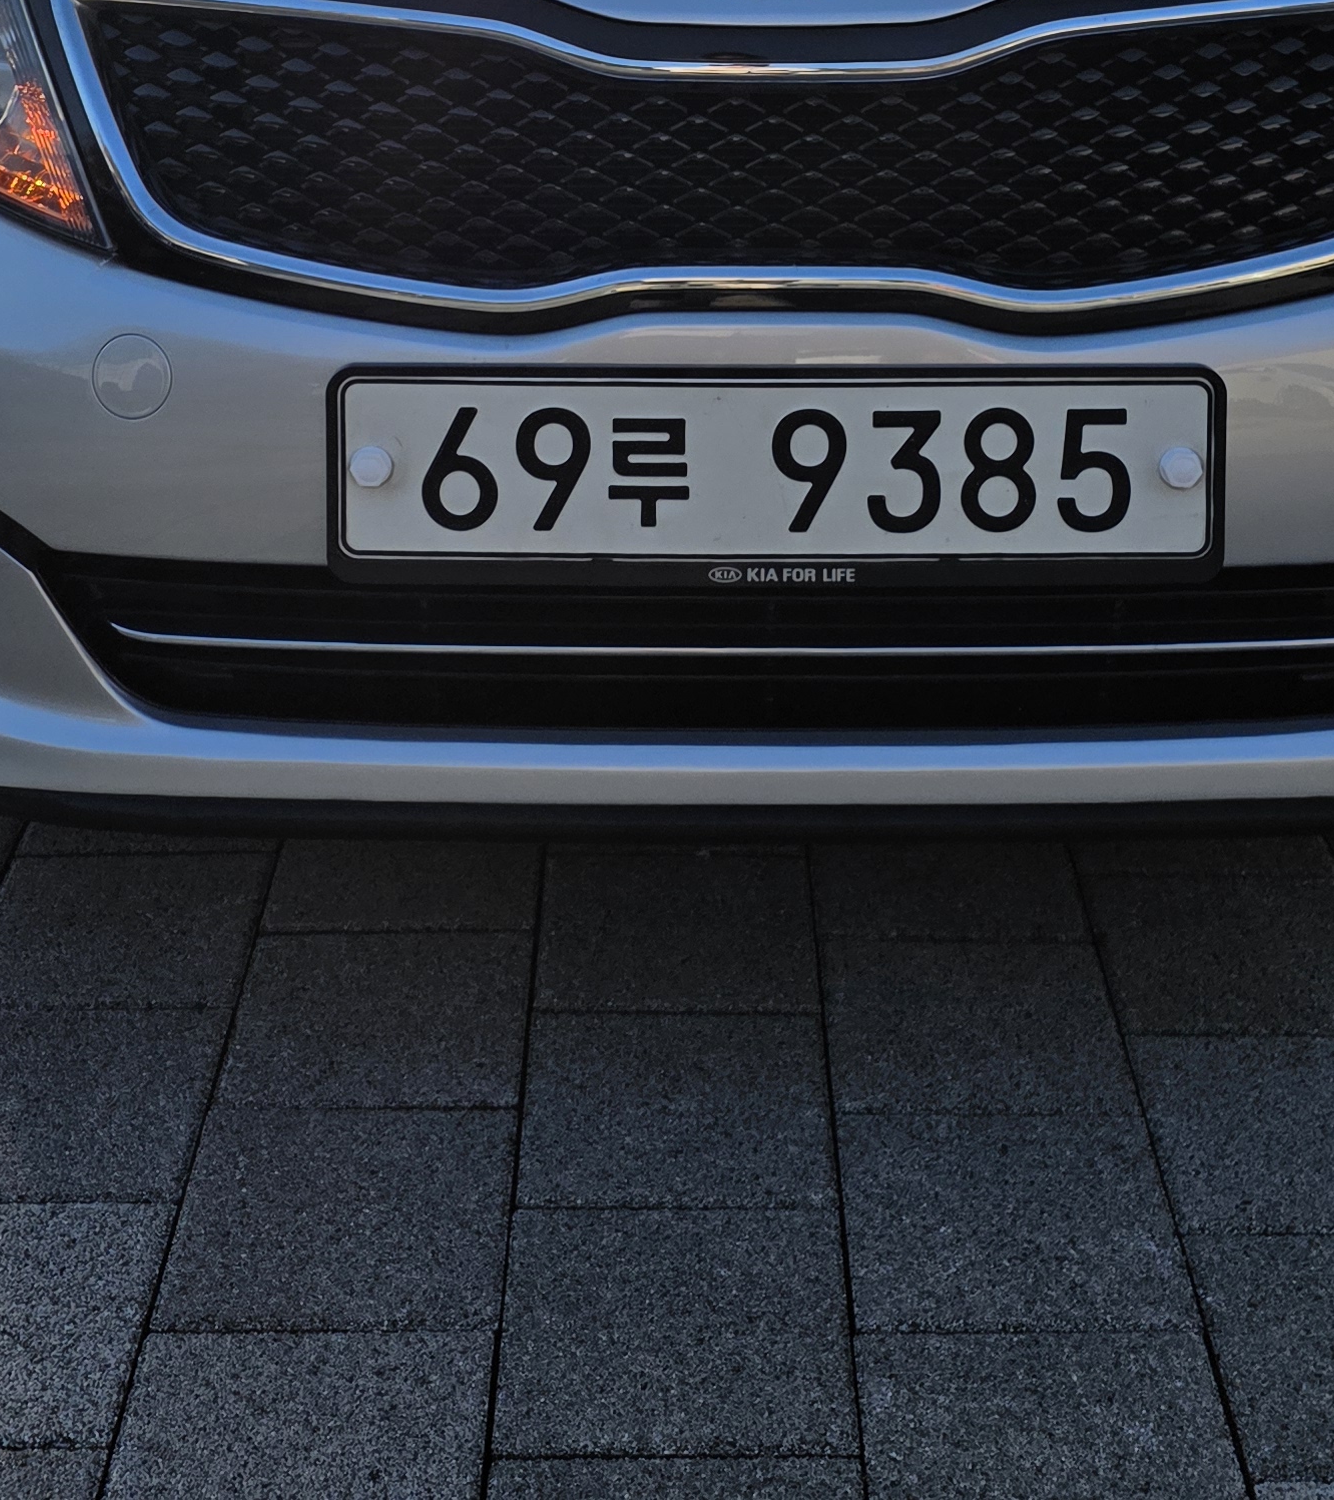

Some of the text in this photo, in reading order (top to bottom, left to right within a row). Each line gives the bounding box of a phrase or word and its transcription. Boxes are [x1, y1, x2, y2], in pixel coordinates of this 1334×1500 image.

[421, 406, 1132, 534] 69루 9385
[746, 567, 779, 583] KIA
[782, 567, 816, 583] FOR
[822, 567, 856, 583] LIFE
